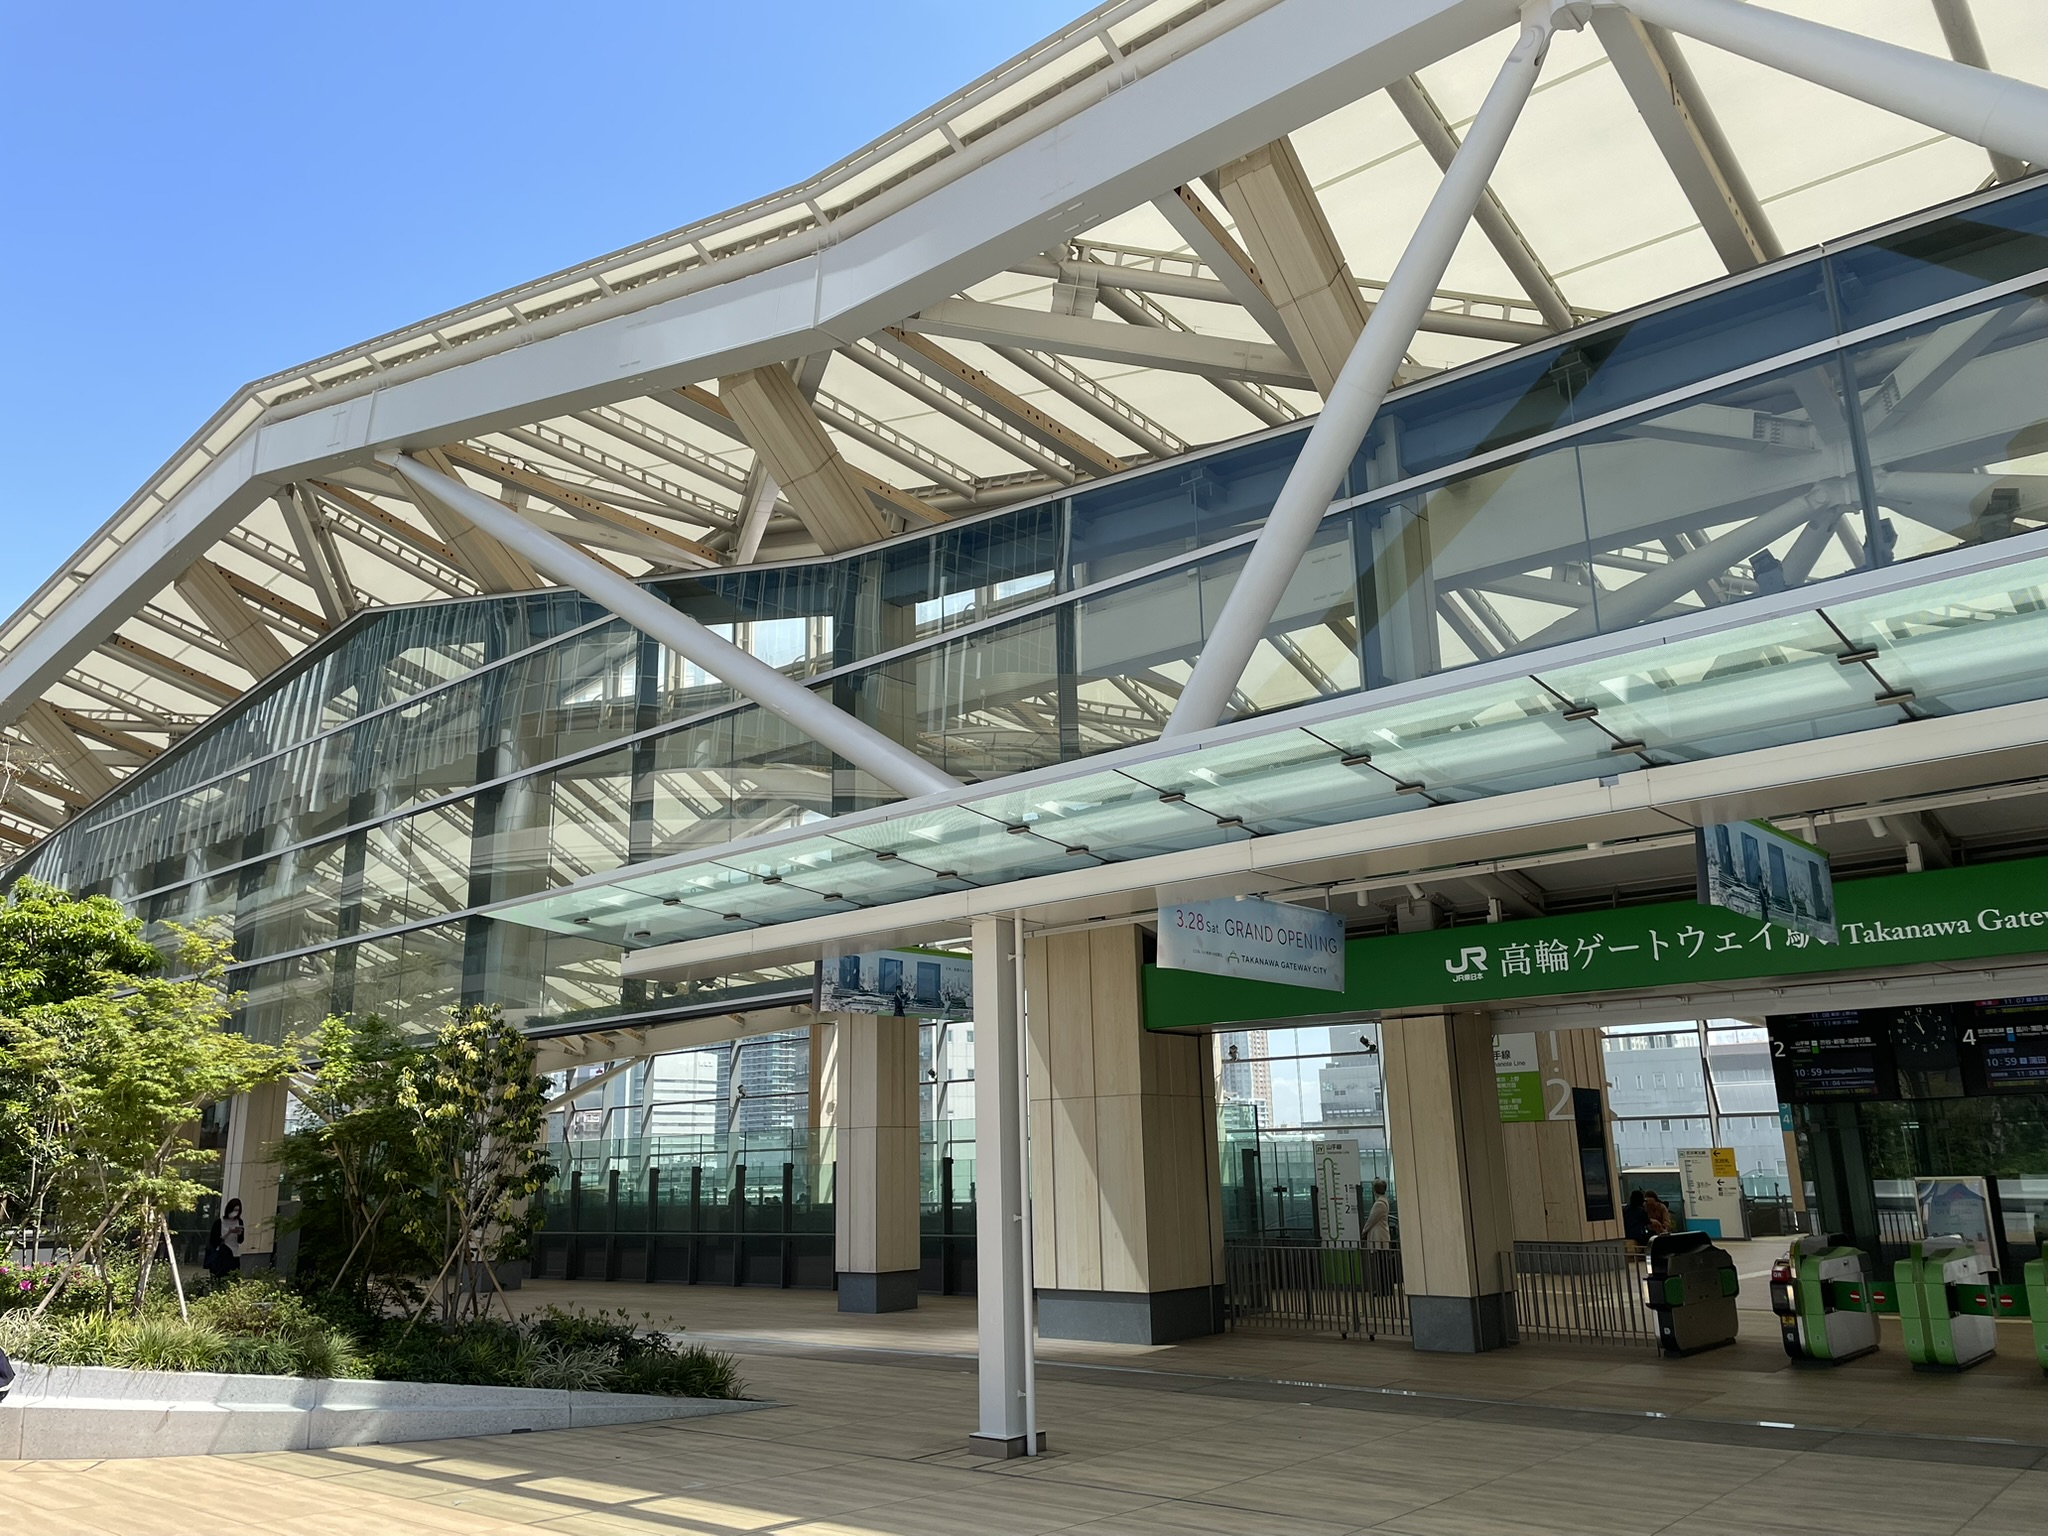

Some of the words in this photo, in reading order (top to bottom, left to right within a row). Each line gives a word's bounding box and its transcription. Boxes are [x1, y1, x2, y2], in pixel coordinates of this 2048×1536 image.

[1176, 909, 1205, 931] 3.28
[1206, 921, 1221, 935] Sat.
[1225, 918, 1273, 943] GRAND
[1277, 928, 1338, 954] OPENING
[1841, 919, 1972, 945] Takanawa
[1241, 955, 1279, 968] TAKANAWA
[1281, 961, 1311, 973] GATEWAY
[1312, 966, 1327, 975] CITY
[1445, 946, 1489, 974] JR
[1452, 972, 1484, 983] JR東日本
[1962, 1029, 1976, 1046] 4
[1773, 1042, 1786, 1057] 2
[1986, 1058, 2018, 1067] 10:59
[1795, 1068, 1822, 1078] 10:59
[1546, 1078, 1575, 1120] 2
[1783, 1114, 1790, 1124] 4
[1345, 1204, 1351, 1214] 2
